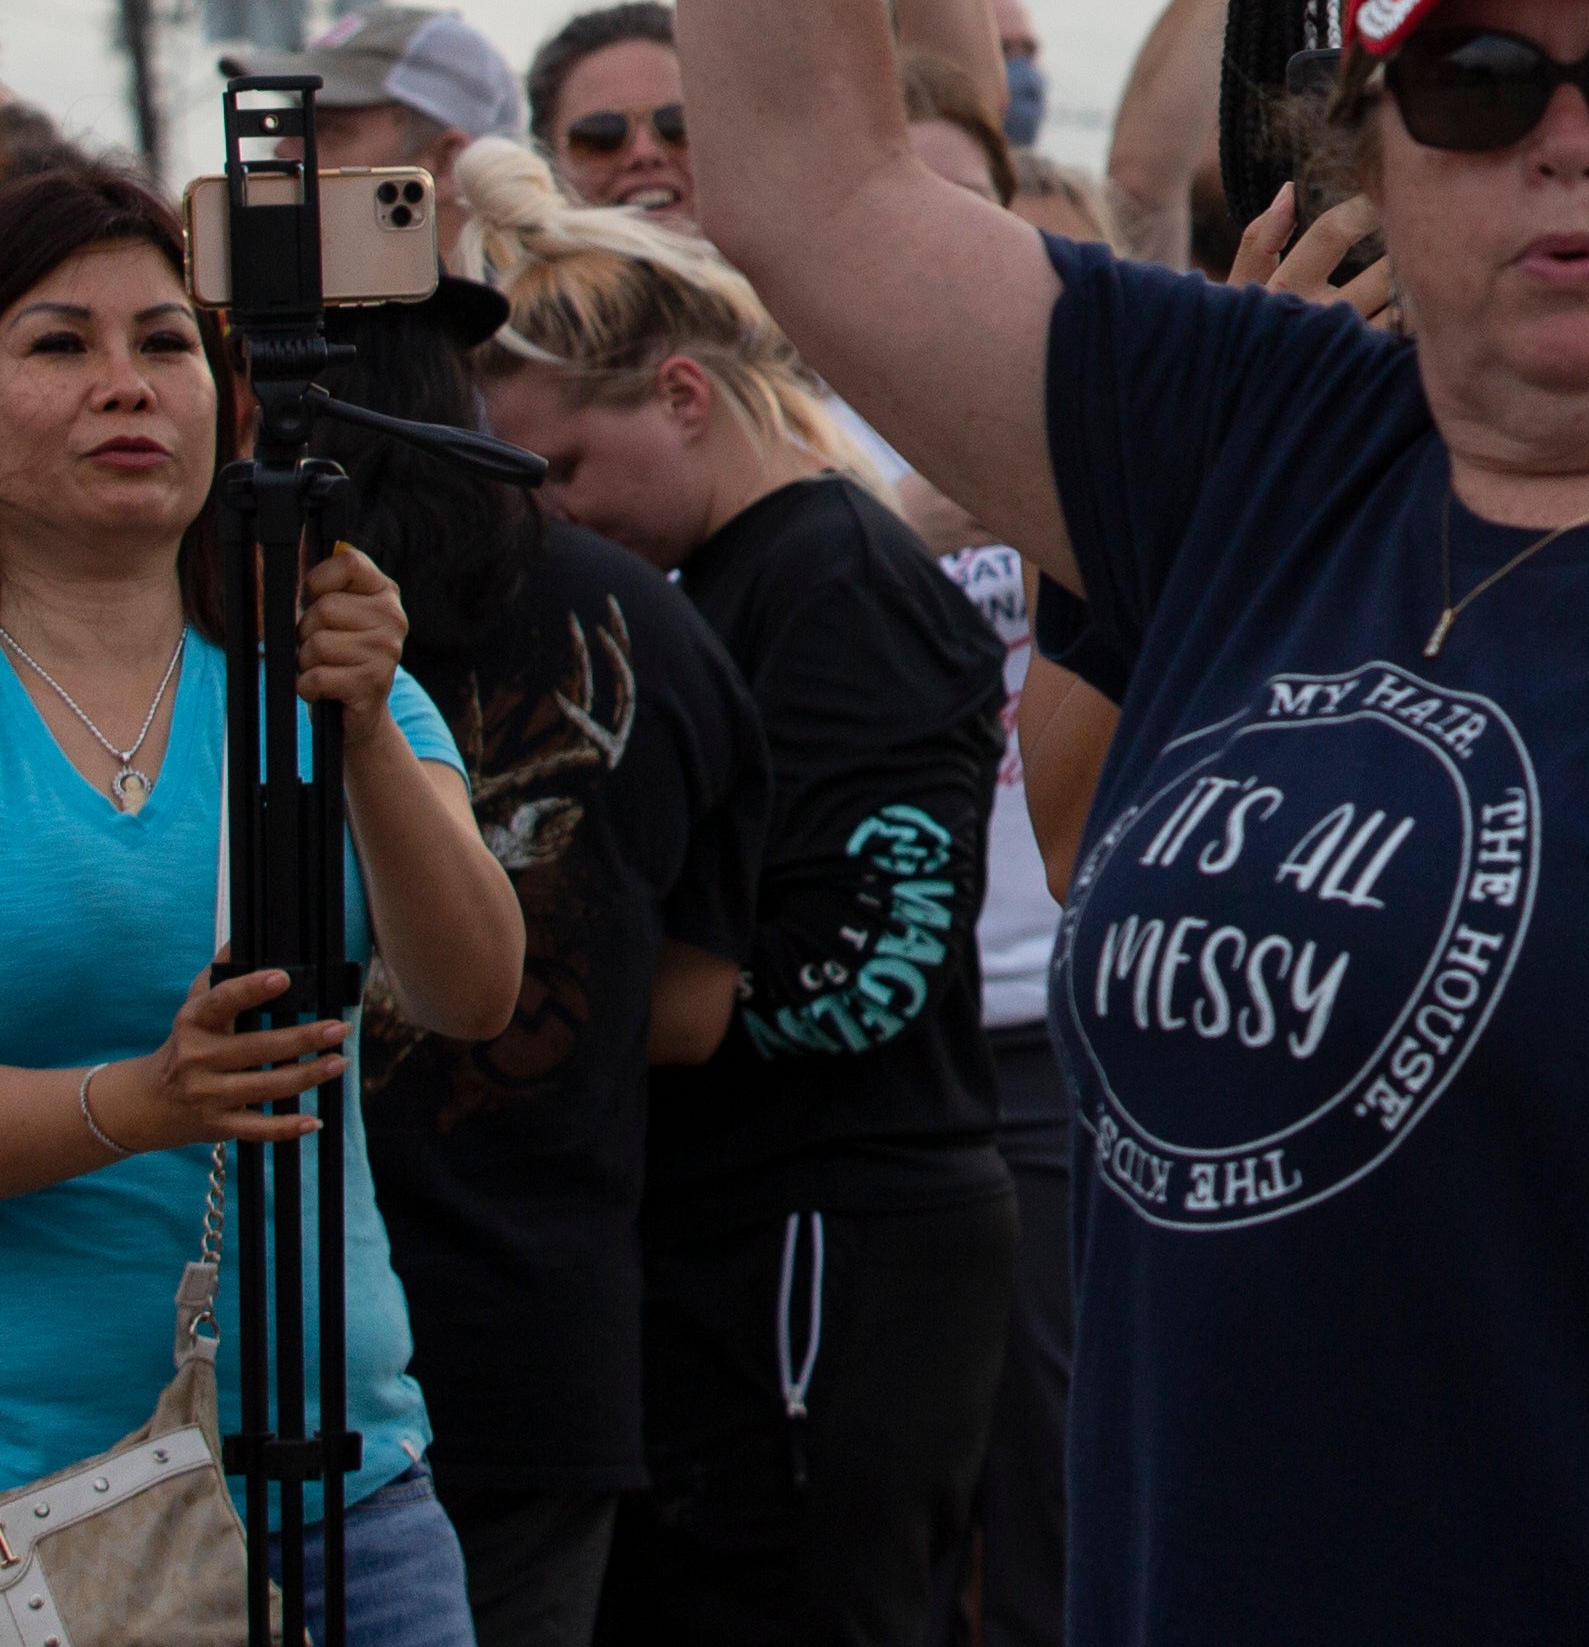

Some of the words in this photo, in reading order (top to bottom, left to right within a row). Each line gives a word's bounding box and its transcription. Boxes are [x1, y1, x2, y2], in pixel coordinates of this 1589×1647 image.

[1266, 680, 1361, 717] MY
[1140, 775, 1284, 875] IT'S
[1274, 801, 1416, 910] ALL
[1468, 785, 1529, 908] THE
[1094, 914, 1351, 1060] MESSY
[1183, 1146, 1304, 1212] THE
